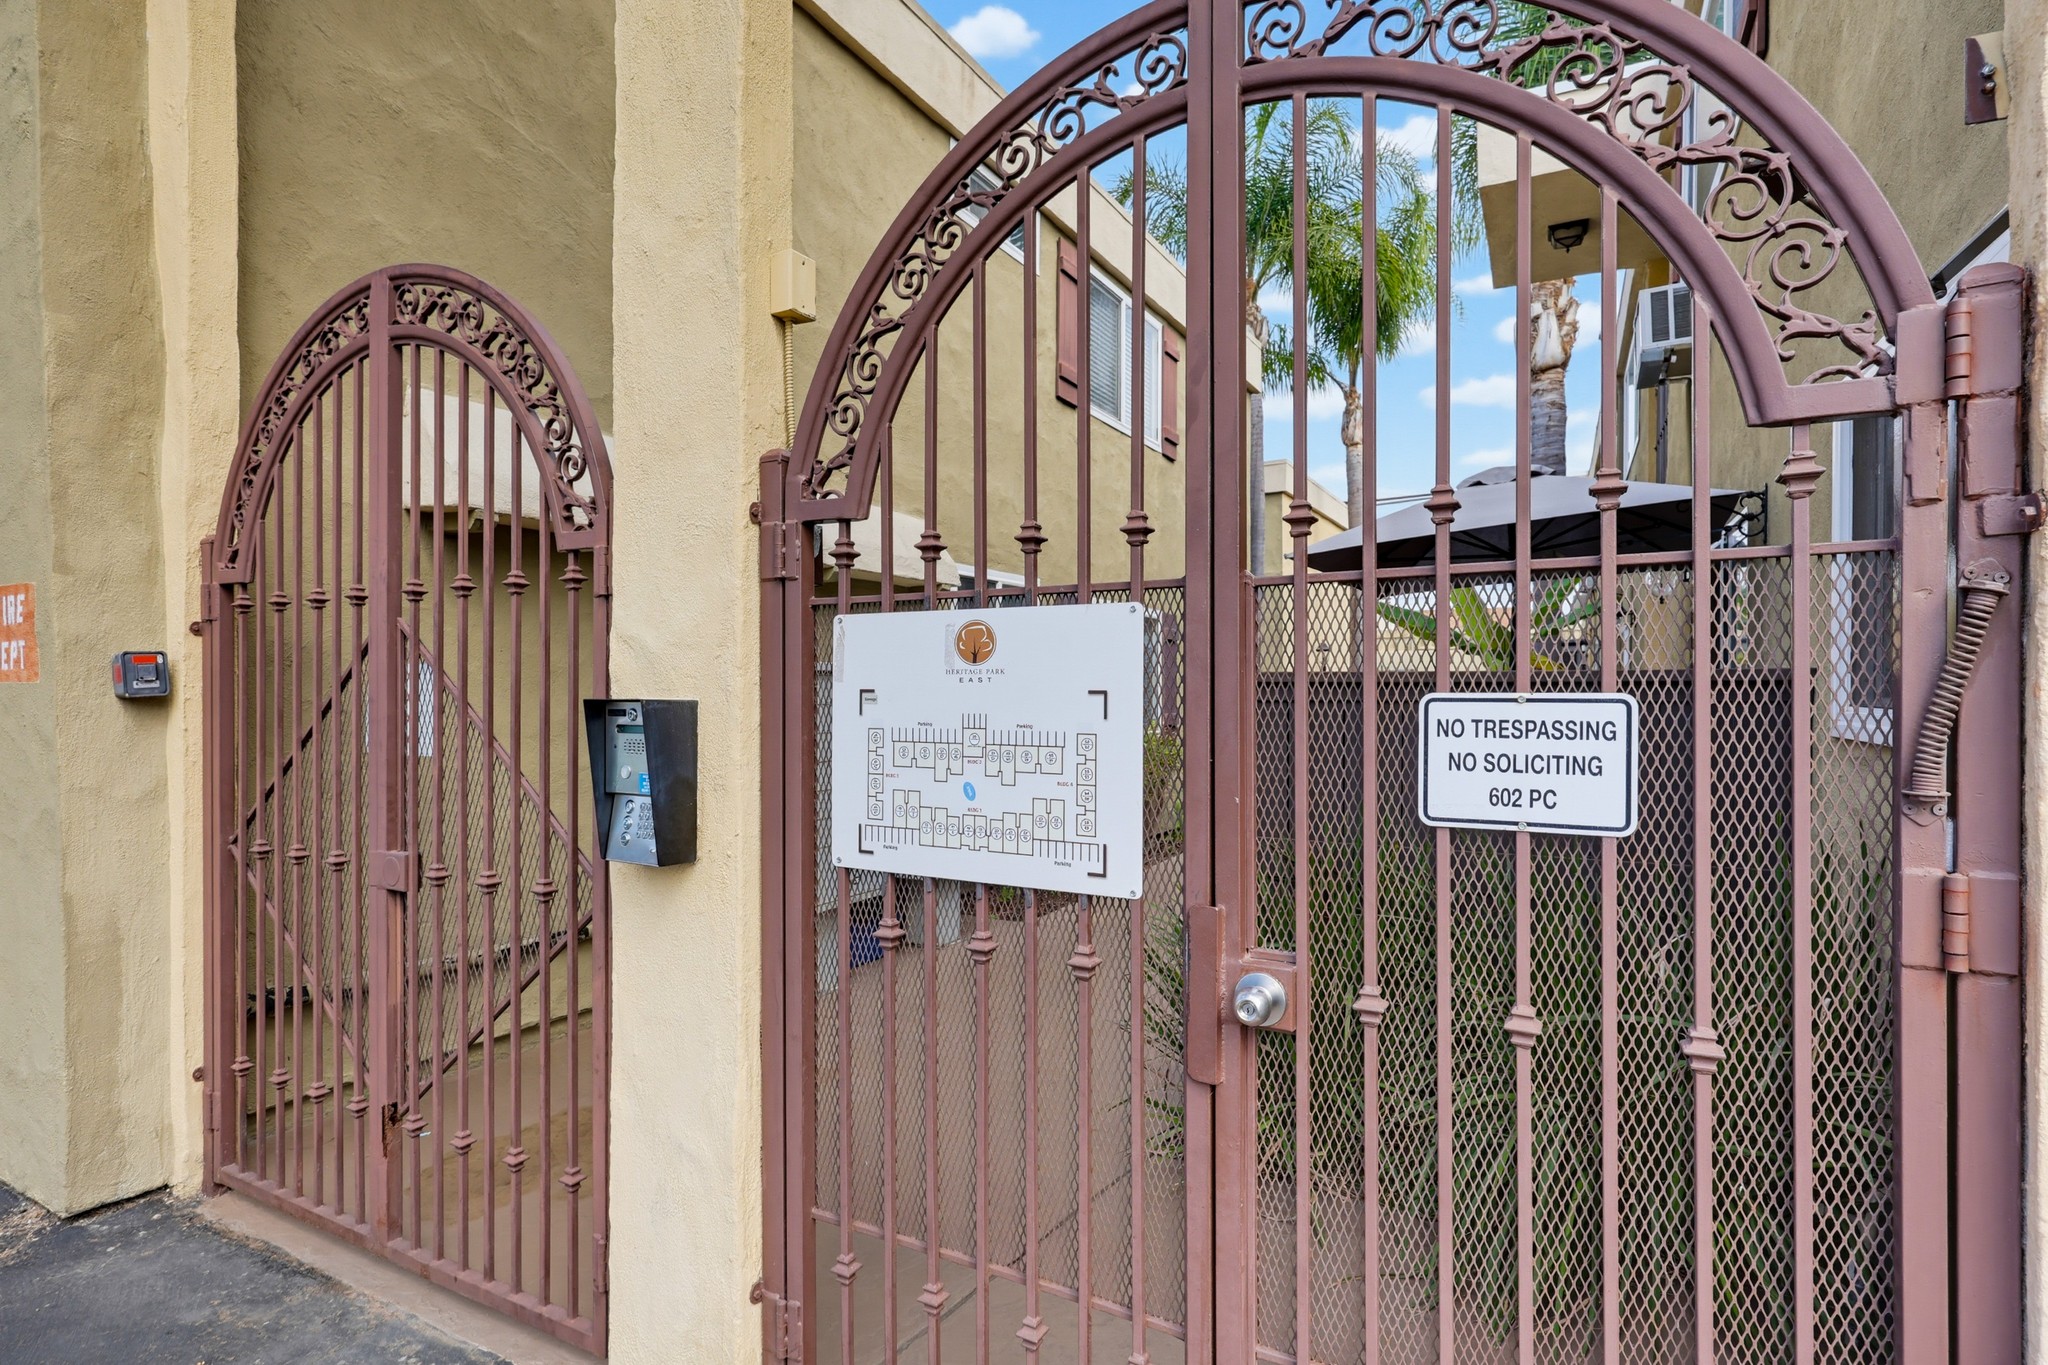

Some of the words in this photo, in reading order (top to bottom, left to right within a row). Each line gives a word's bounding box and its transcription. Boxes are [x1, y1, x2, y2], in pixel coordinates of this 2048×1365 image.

[2, 593, 25, 626] IRE
[1, 640, 25, 670] EPT
[959, 676, 992, 684] EAST
[1436, 718, 1465, 738] NO
[1471, 718, 1617, 742] TRESPASSING
[1448, 752, 1477, 772] NO
[1483, 752, 1603, 777] SOLICITING
[1488, 787, 1523, 808] 602
[1529, 788, 1557, 810] PC
[1054, 860, 1072, 868] Parking
